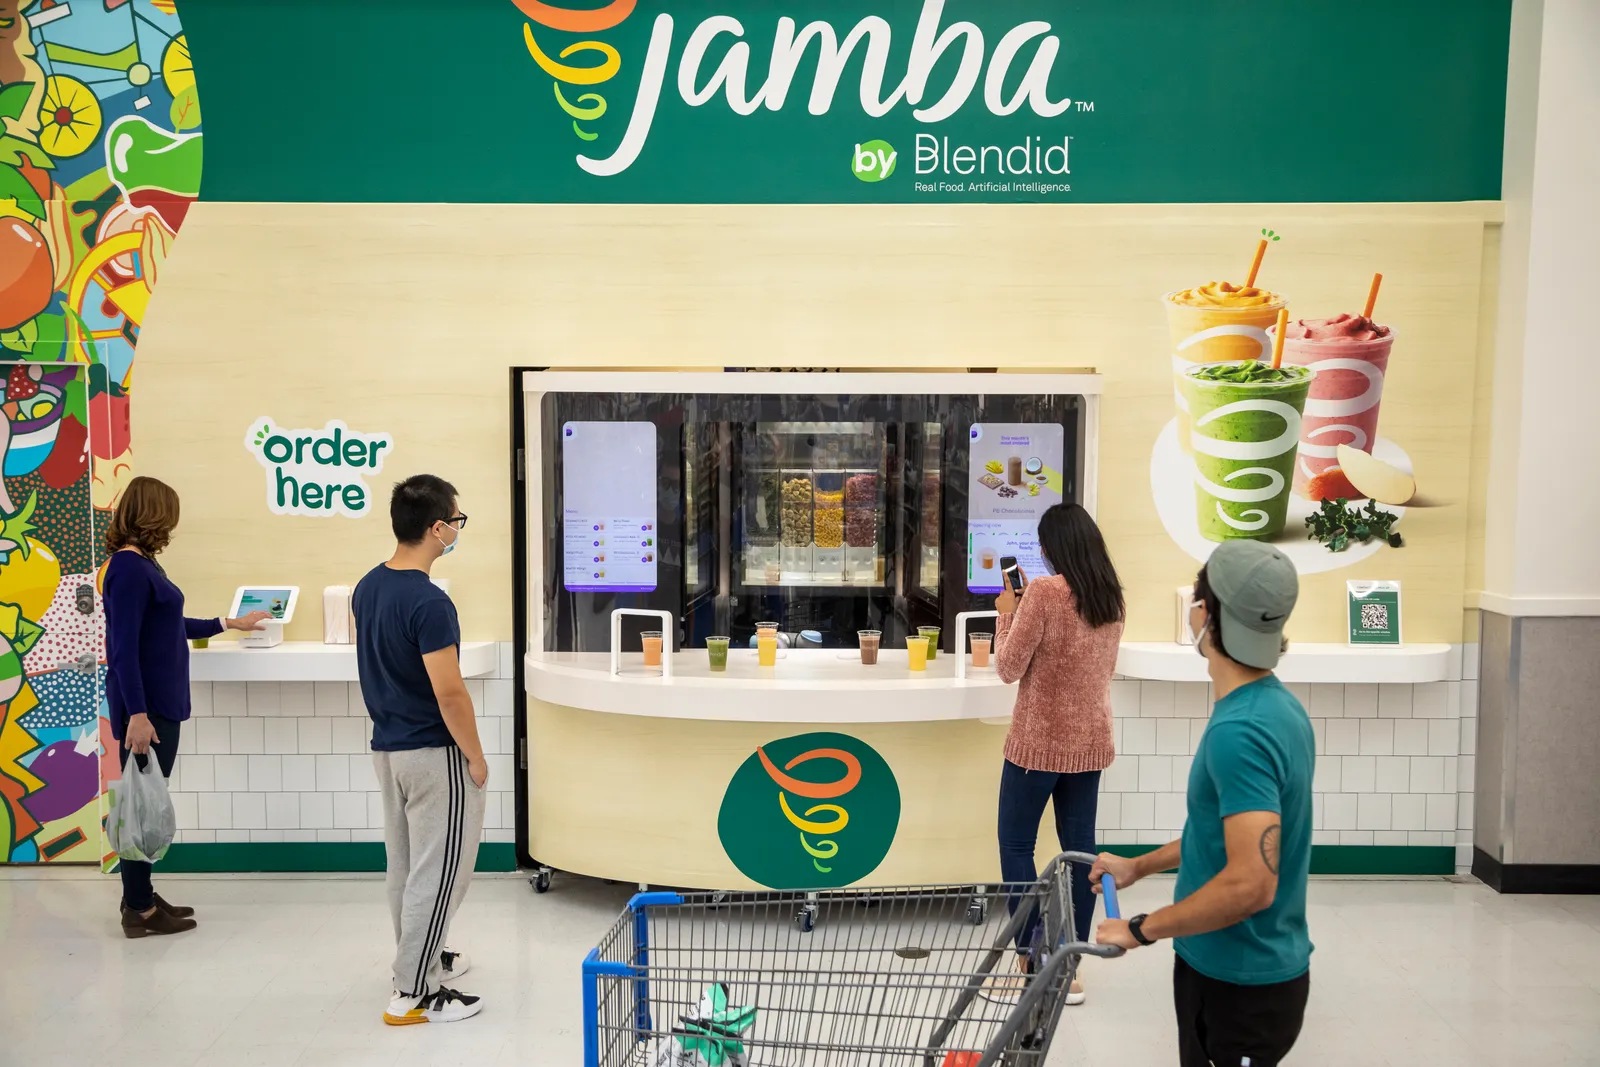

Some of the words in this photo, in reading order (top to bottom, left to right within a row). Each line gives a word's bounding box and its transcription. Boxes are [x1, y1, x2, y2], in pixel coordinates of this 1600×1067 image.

[576, 0, 1071, 177] jamba
[855, 143, 898, 179] by
[915, 134, 1071, 175] Blendid
[915, 182, 937, 192] Real
[939, 182, 966, 192] Food.
[968, 182, 1011, 193] Artificial
[1012, 182, 1072, 195] Intelligence.
[263, 428, 387, 468] order
[276, 466, 365, 511] here
[1352, 628, 1358, 636] 2
